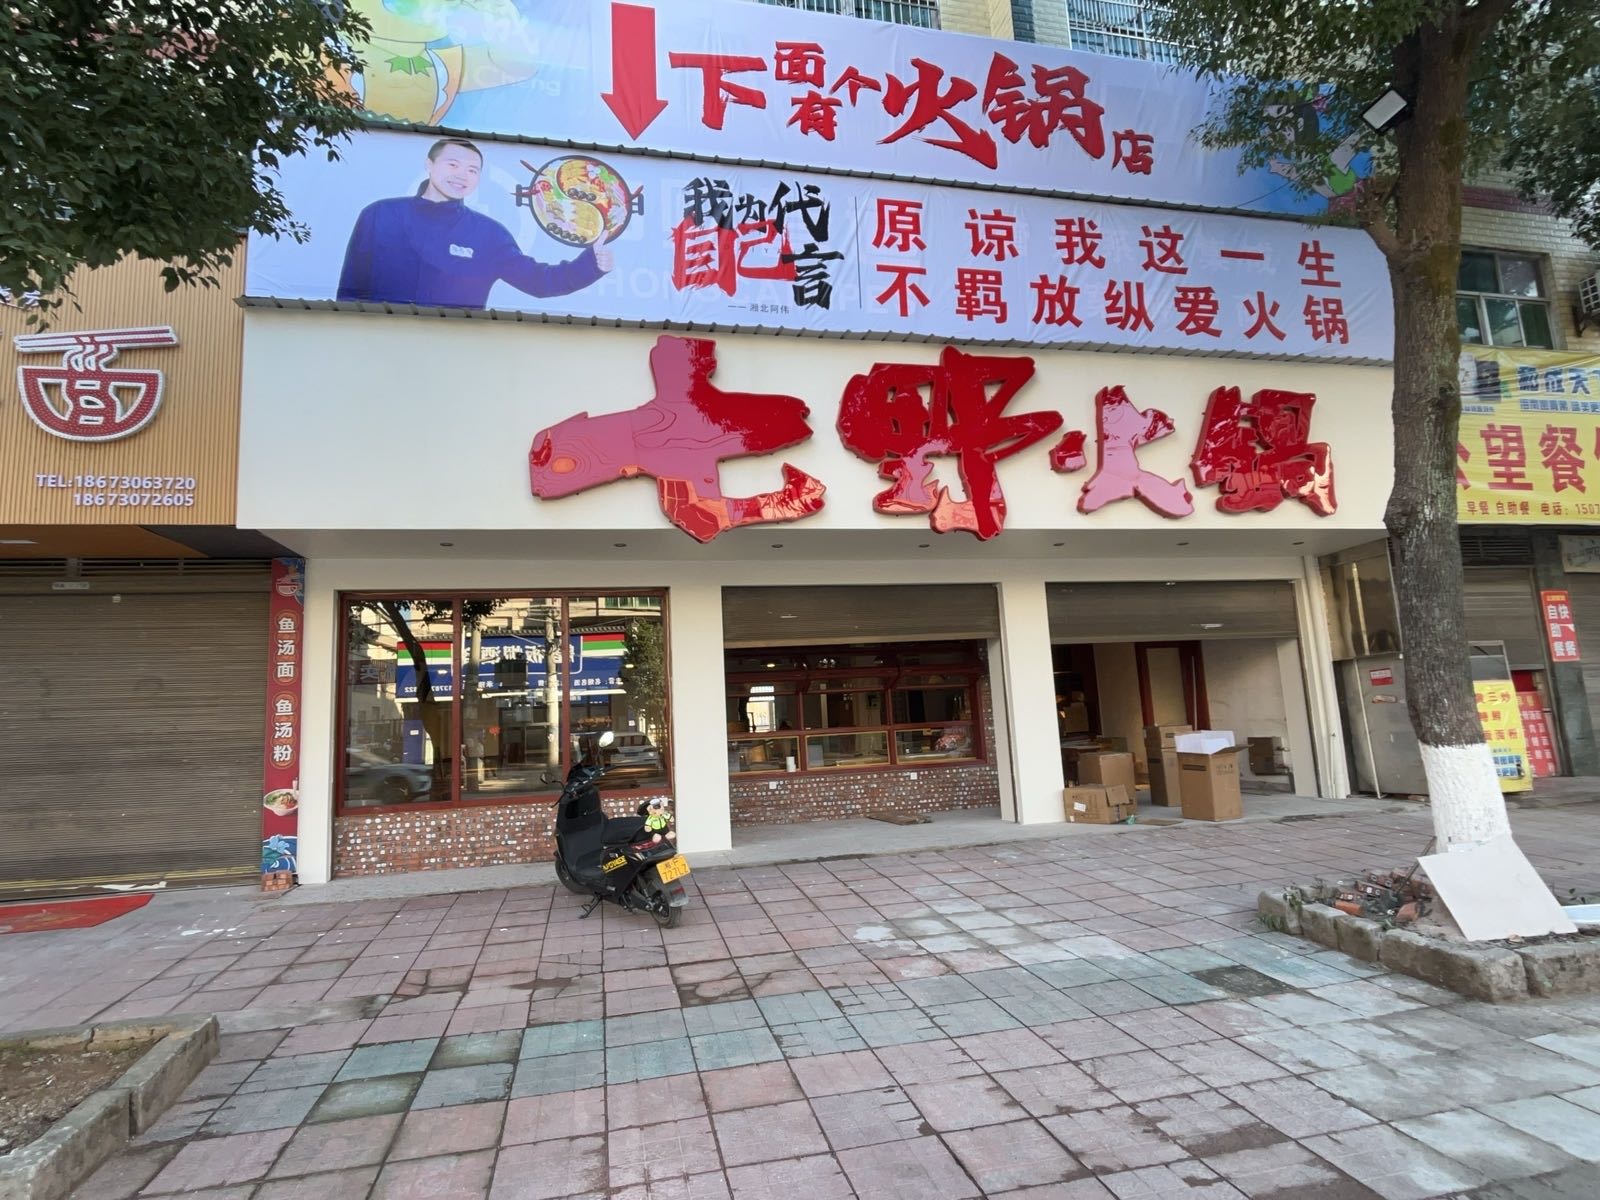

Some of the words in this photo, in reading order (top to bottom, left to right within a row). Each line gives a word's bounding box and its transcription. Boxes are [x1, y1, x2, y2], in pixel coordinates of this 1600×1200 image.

[872, 198, 1342, 289] 原谅我这一生
[876, 264, 1350, 344] 不羁放纵爱火锅
[36, 473, 196, 490] TEL:18673063720
[1456, 423, 1600, 494] 望餐
[74, 492, 195, 506] 18673072605
[277, 616, 297, 678] 鱼汤面
[273, 698, 294, 763] 鱼汤粉
